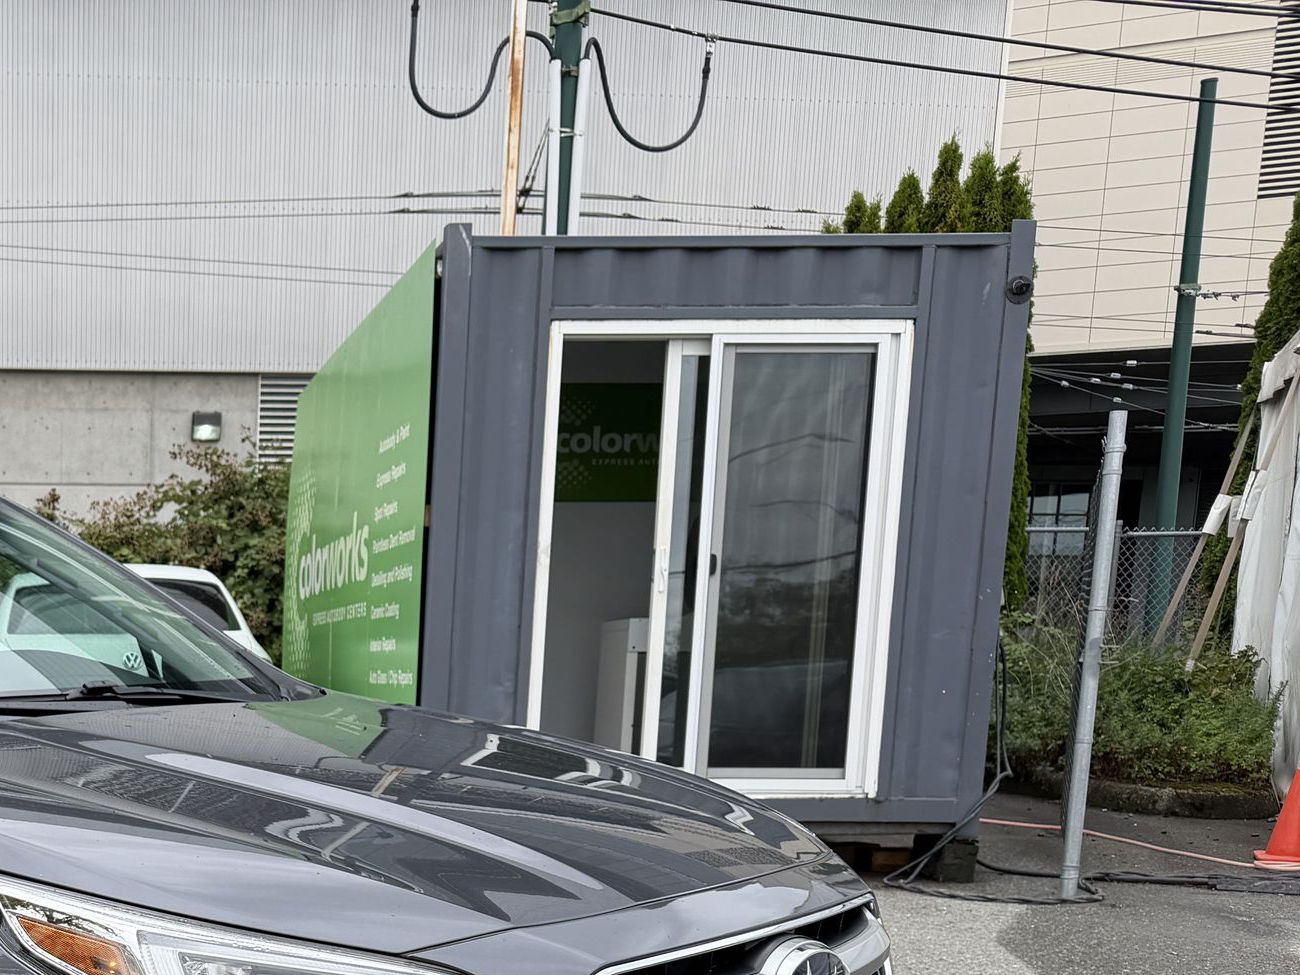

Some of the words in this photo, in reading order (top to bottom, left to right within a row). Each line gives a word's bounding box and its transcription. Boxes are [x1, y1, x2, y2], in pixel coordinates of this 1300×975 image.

[591, 457, 635, 466] EXPRESS
[299, 510, 369, 601] colorworks
[346, 601, 367, 619] CENTERS
